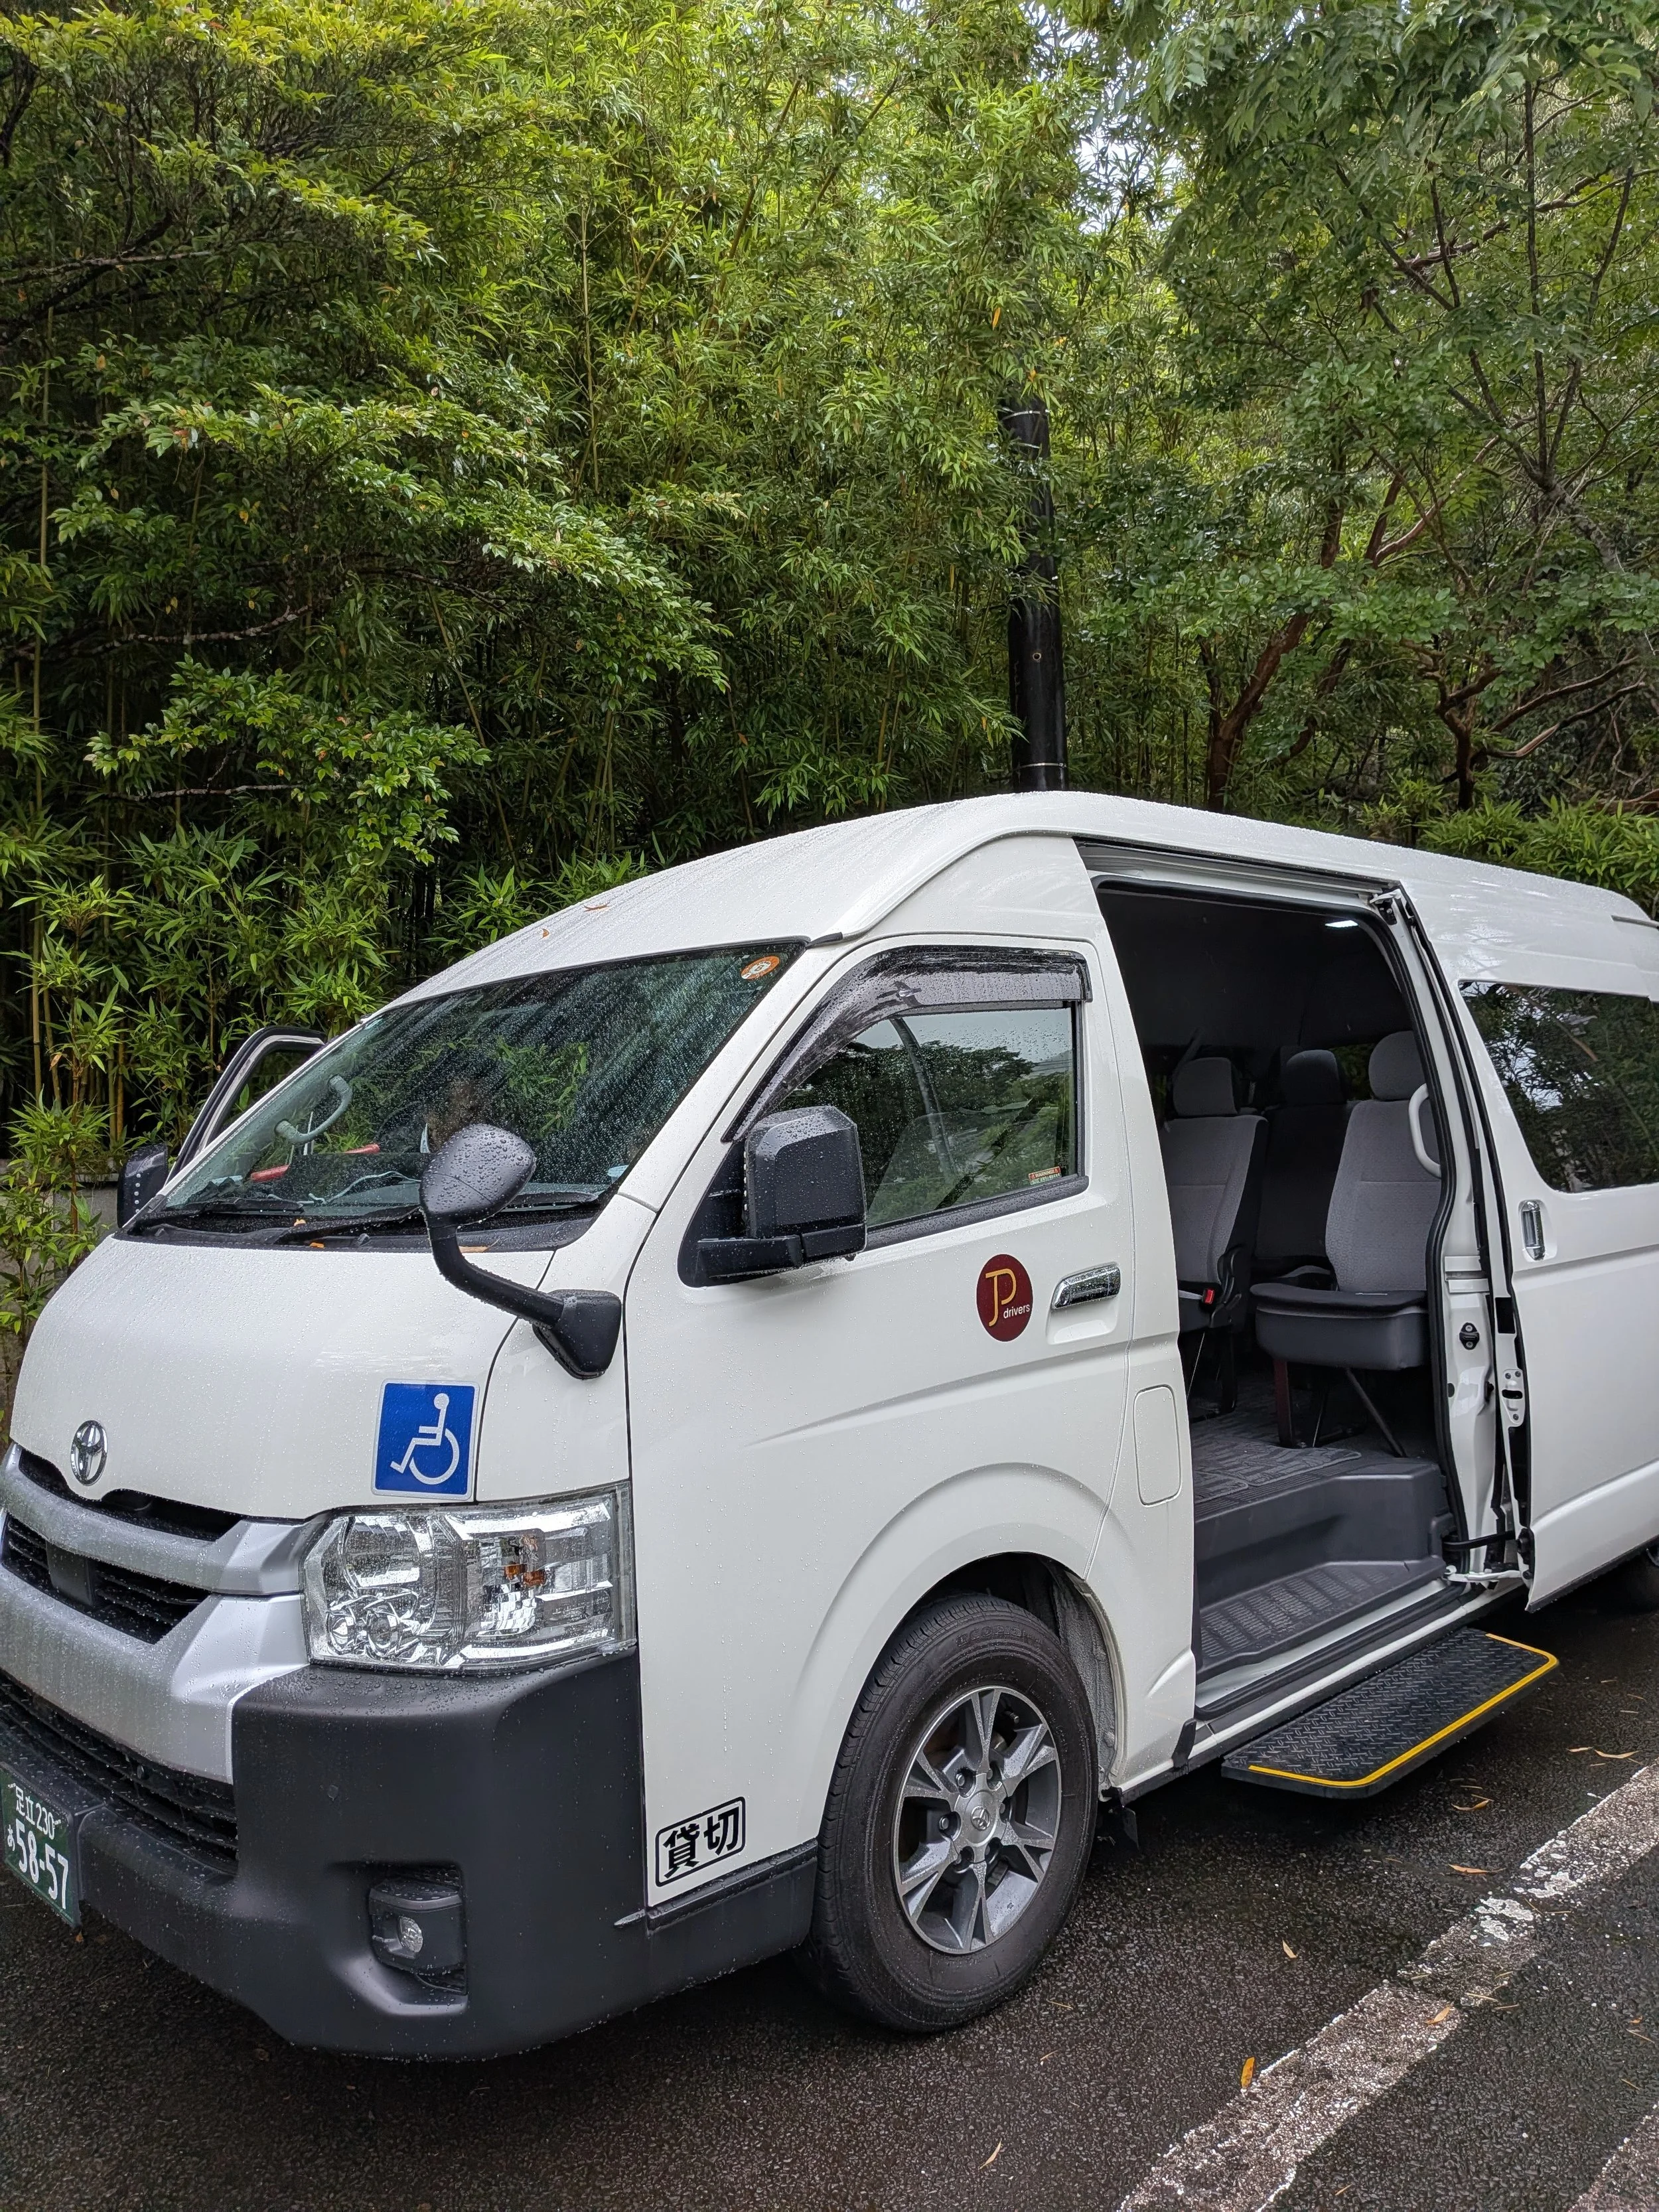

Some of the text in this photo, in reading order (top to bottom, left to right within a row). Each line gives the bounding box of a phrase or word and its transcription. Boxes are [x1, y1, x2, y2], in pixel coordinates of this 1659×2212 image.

[1003, 1303, 1031, 1319] drivers
[15, 1818, 68, 1910] 58-57
[662, 1806, 739, 1879] 貸切
